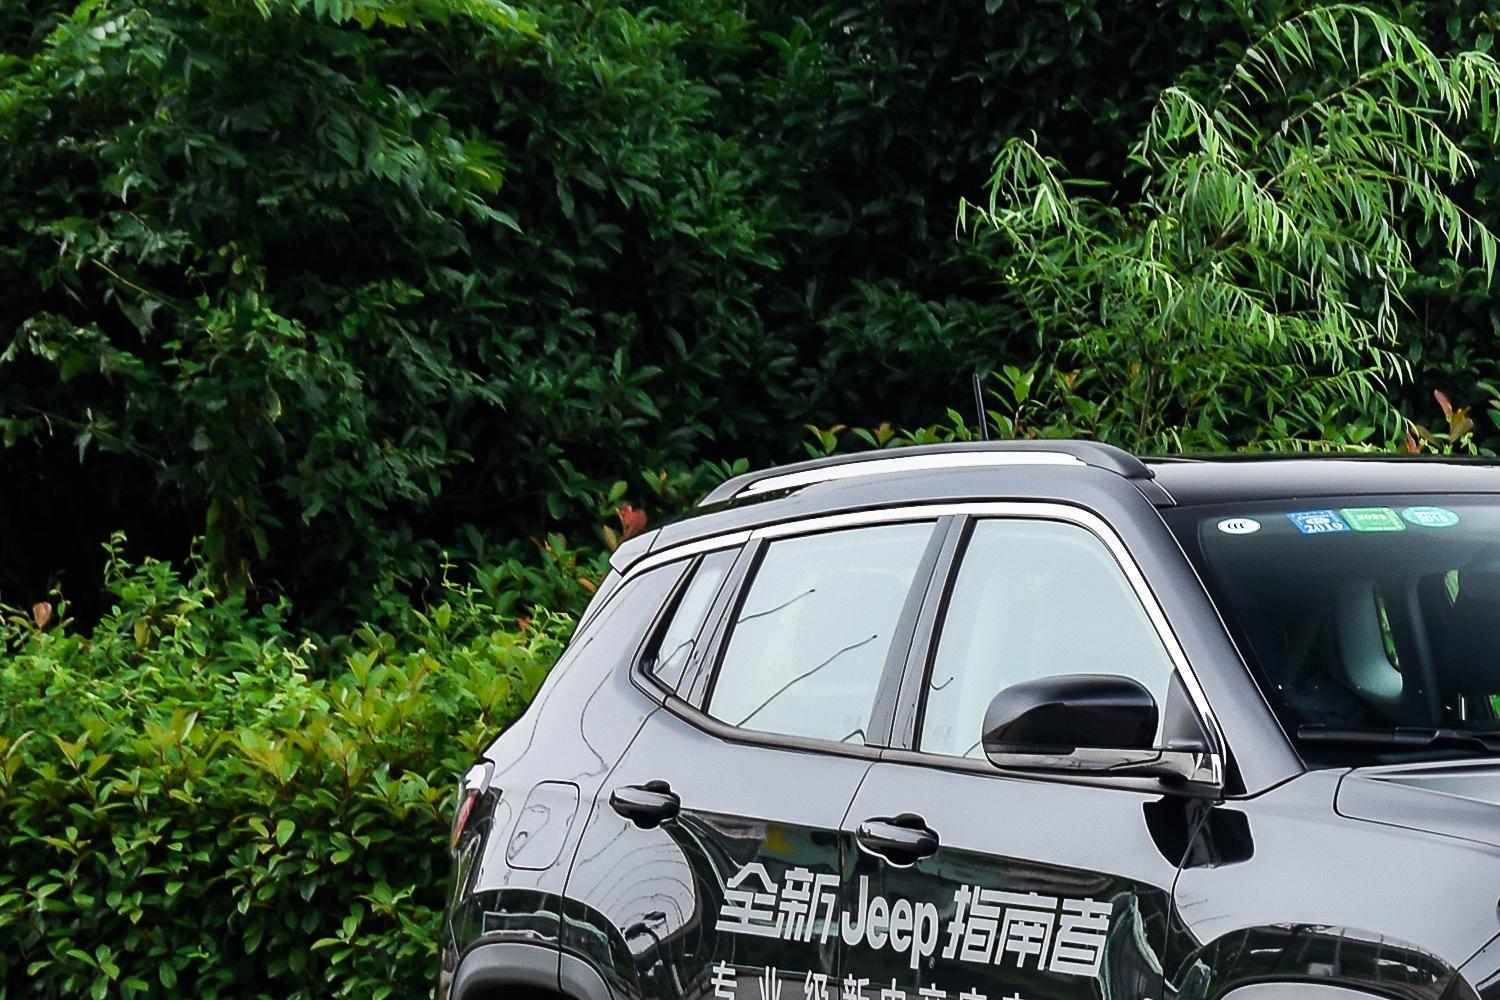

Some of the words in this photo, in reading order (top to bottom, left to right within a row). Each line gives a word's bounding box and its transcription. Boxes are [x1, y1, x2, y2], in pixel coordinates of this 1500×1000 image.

[715, 862, 840, 944] 全新
[841, 875, 939, 970] Jeep
[942, 884, 1113, 977] 指南者
